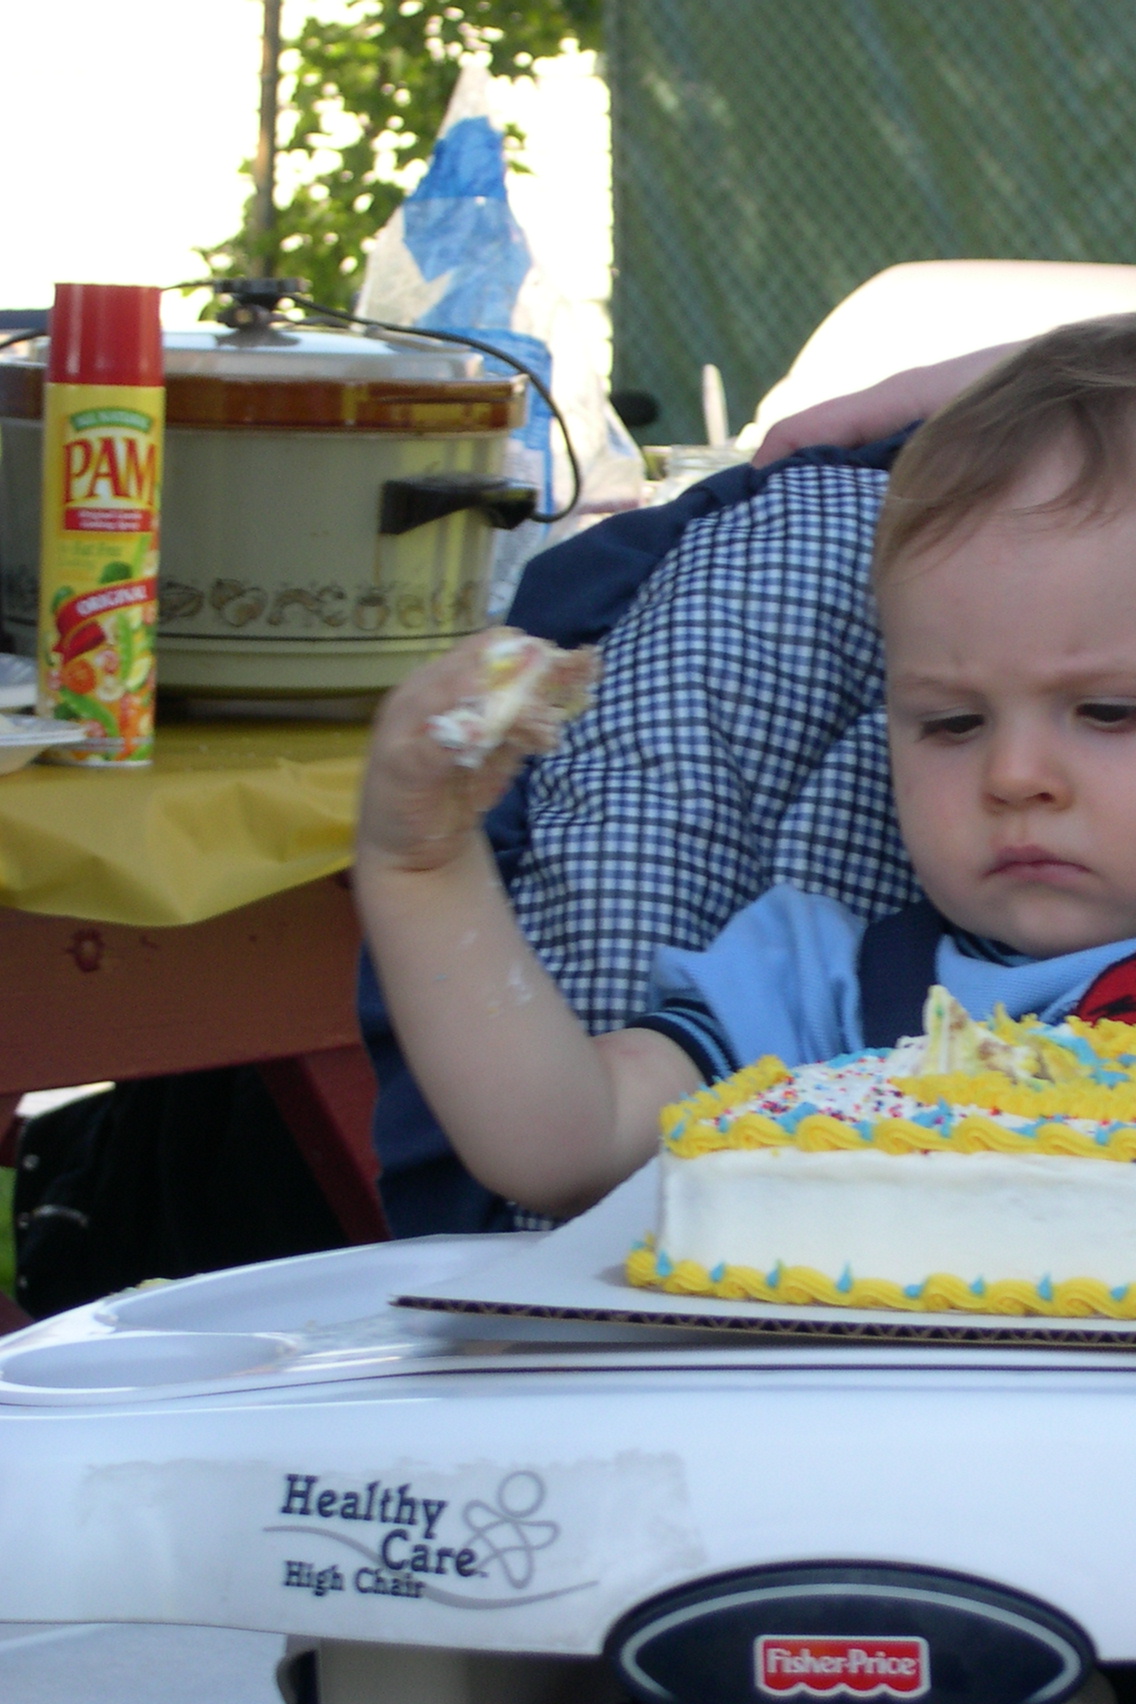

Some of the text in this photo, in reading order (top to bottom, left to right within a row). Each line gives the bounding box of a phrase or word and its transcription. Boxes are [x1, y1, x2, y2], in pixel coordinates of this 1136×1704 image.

[63, 437, 156, 506] PAM
[76, 585, 147, 616] ORIGINAL
[280, 1473, 447, 1540] Healthy
[381, 1529, 478, 1577] Care
[284, 1560, 425, 1598] High Chair
[766, 1648, 917, 1675] Fisher-Price
